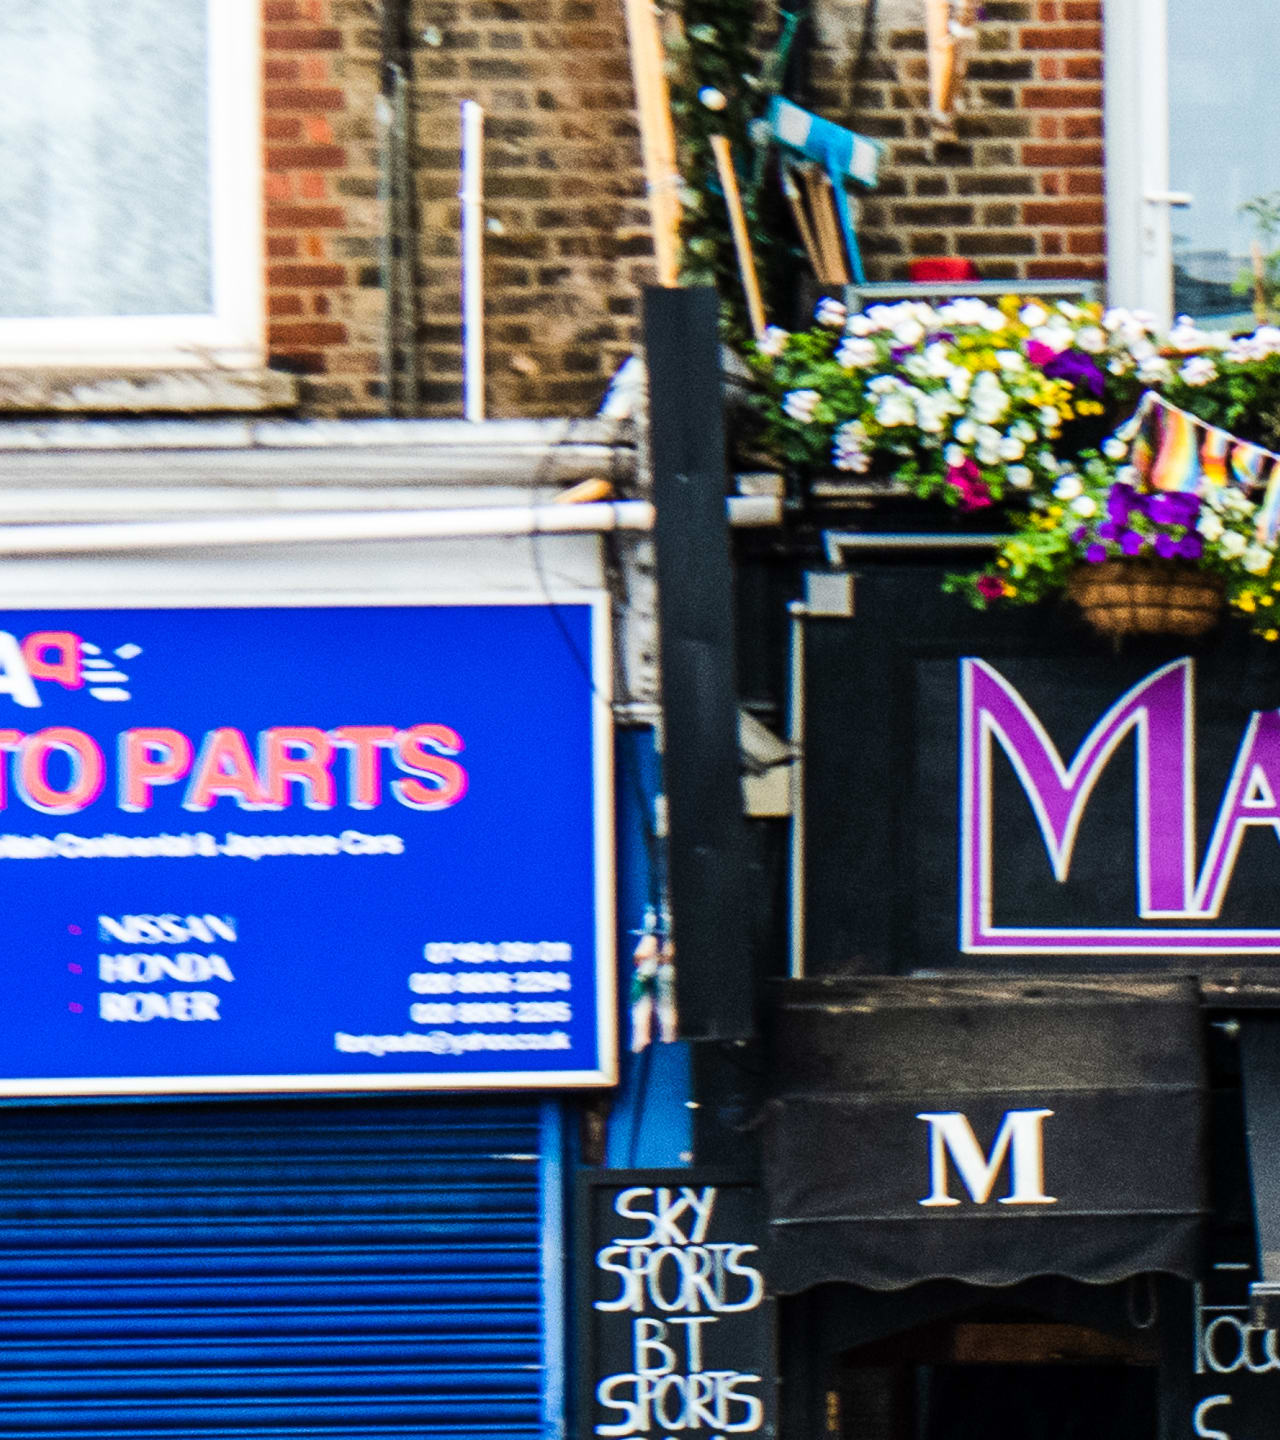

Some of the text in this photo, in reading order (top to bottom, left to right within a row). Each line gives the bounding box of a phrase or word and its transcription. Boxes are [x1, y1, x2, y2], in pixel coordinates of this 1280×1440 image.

[116, 723, 470, 813] PARTS
[98, 915, 237, 943] NISSAN
[98, 954, 234, 983] HONDA
[98, 991, 221, 1022] ROVER
[917, 1108, 1058, 1207] M
[612, 1186, 718, 1246] SKY
[592, 1243, 764, 1313] SPORTS
[632, 1315, 719, 1376] BT
[593, 1371, 764, 1436] SPORTS
